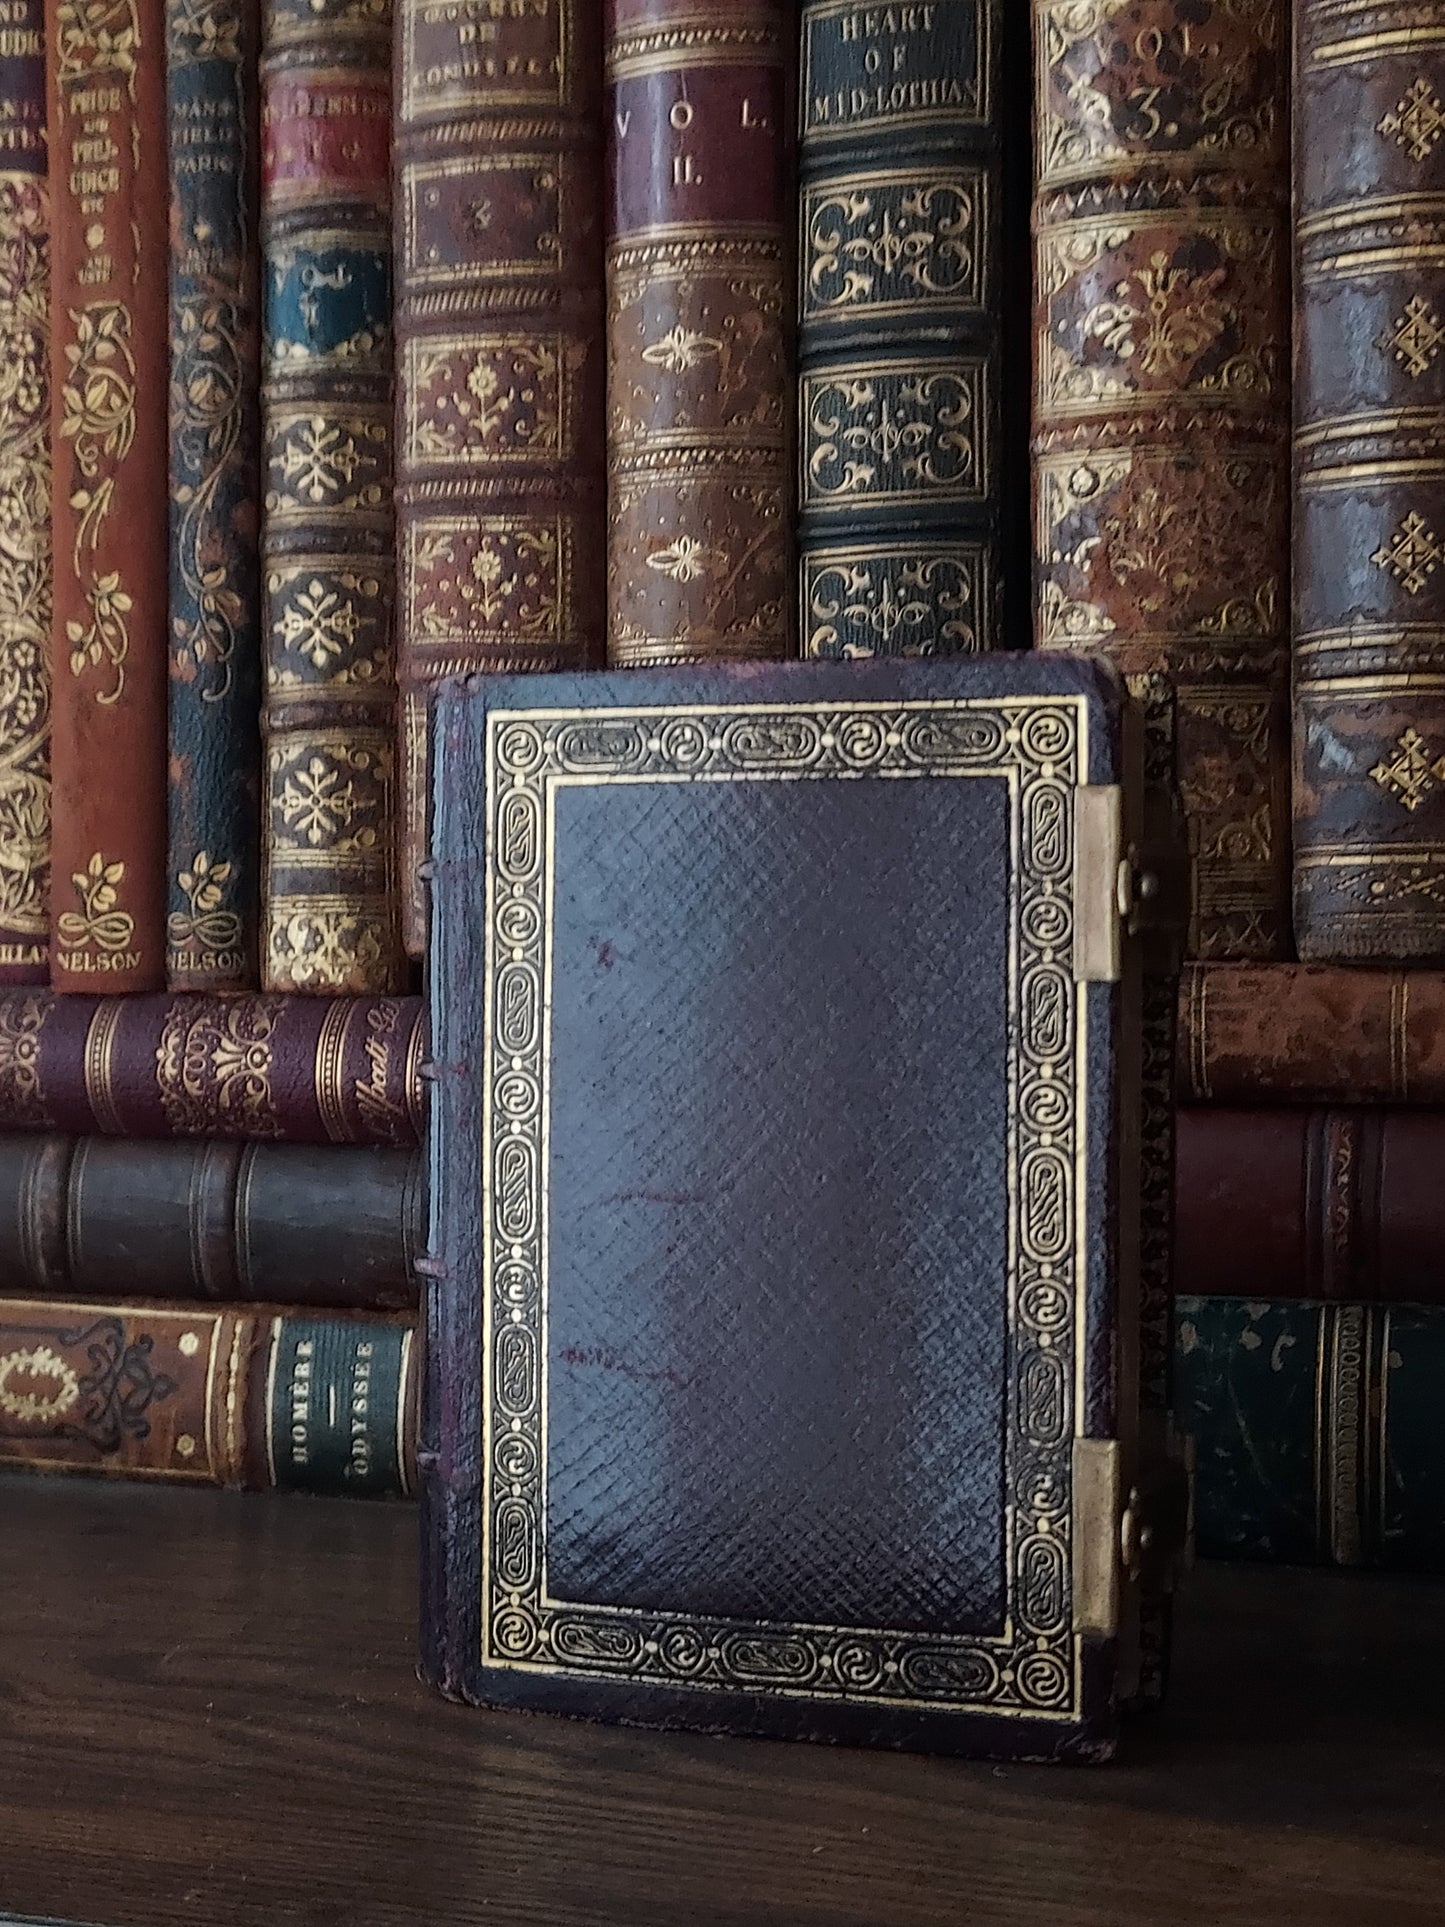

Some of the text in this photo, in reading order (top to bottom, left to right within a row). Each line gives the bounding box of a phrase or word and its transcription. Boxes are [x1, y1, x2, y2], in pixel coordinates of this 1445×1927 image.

[842, 4, 936, 42] HEART
[864, 45, 907, 76] OF
[56, 951, 141, 974] NELSON
[165, 950, 246, 973] NELSON
[350, 1341, 373, 1476] ODYSSÉE
